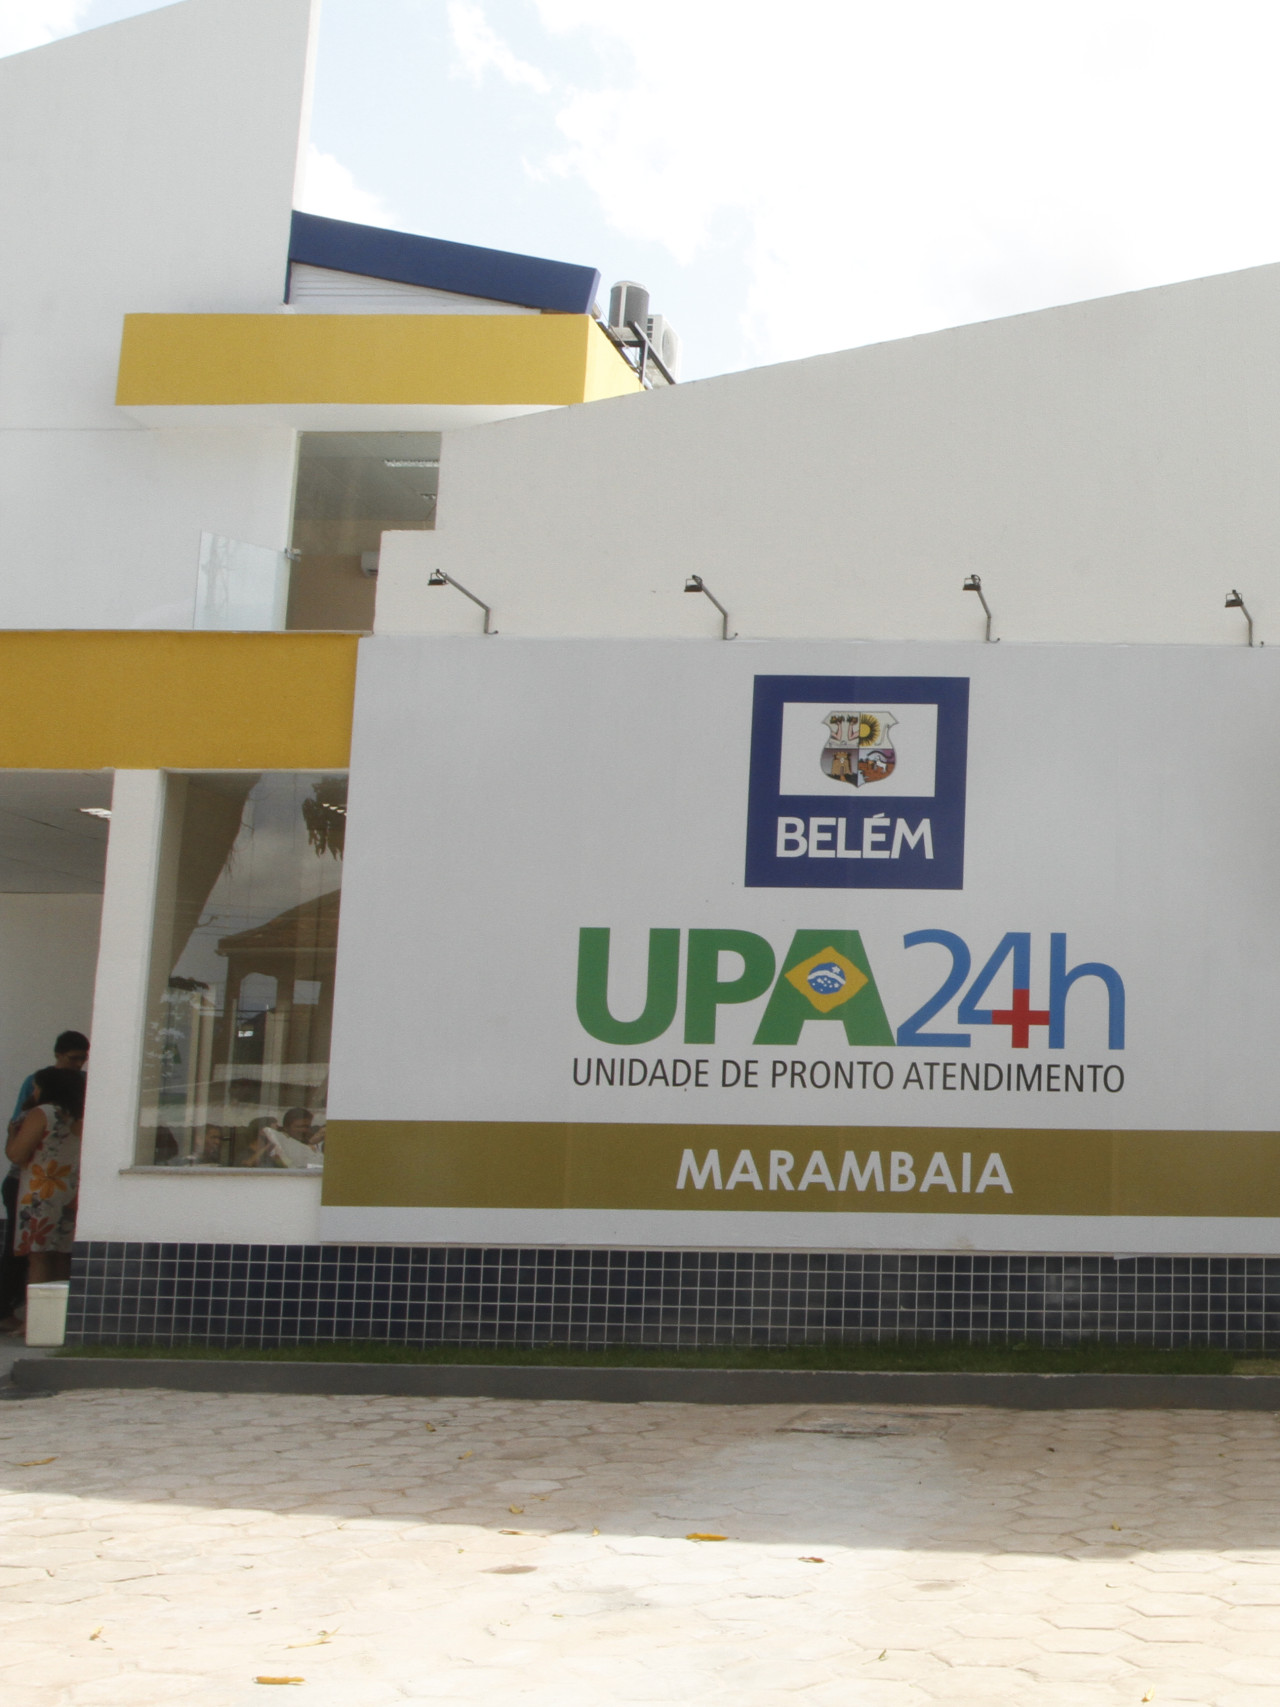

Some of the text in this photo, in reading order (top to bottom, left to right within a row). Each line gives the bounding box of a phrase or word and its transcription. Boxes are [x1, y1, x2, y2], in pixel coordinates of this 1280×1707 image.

[775, 812, 934, 860] BELÉM
[572, 1057, 1125, 1094] UNIDADE DE PRONTO ATENDIMENTO
[675, 1148, 1014, 1195] MARAMBAIA
